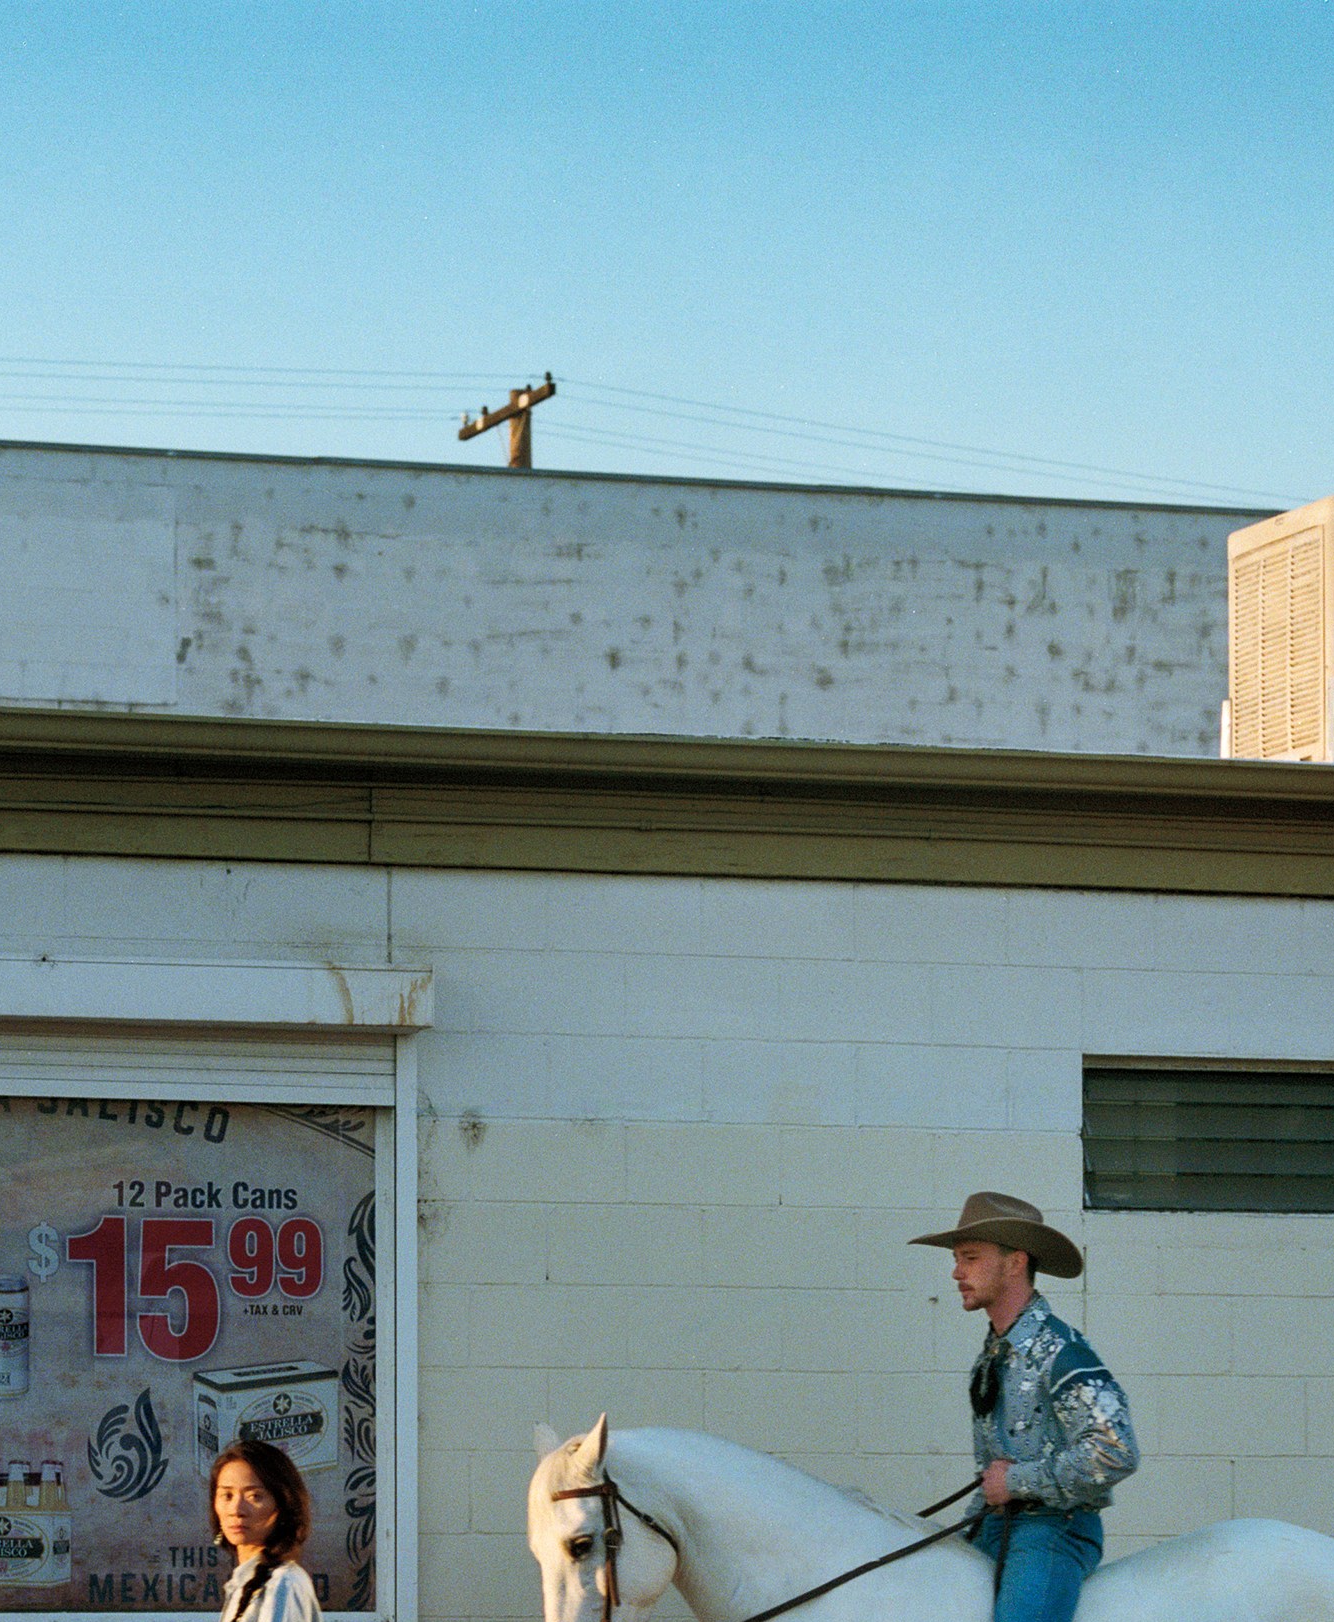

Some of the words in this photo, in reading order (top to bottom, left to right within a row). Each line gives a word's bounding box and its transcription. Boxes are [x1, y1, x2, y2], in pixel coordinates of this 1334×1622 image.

[113, 1181, 145, 1207] 12
[154, 1181, 222, 1209] Pack
[232, 1183, 298, 1210] Cans
[243, 1304, 268, 1317] +TAX
[282, 1304, 303, 1317] CRV
[250, 1414, 313, 1432] ESTRELLA
[257, 1425, 307, 1440] JALISCO
[169, 1546, 217, 1567] THIS
[88, 1572, 224, 1603] MEXICA
